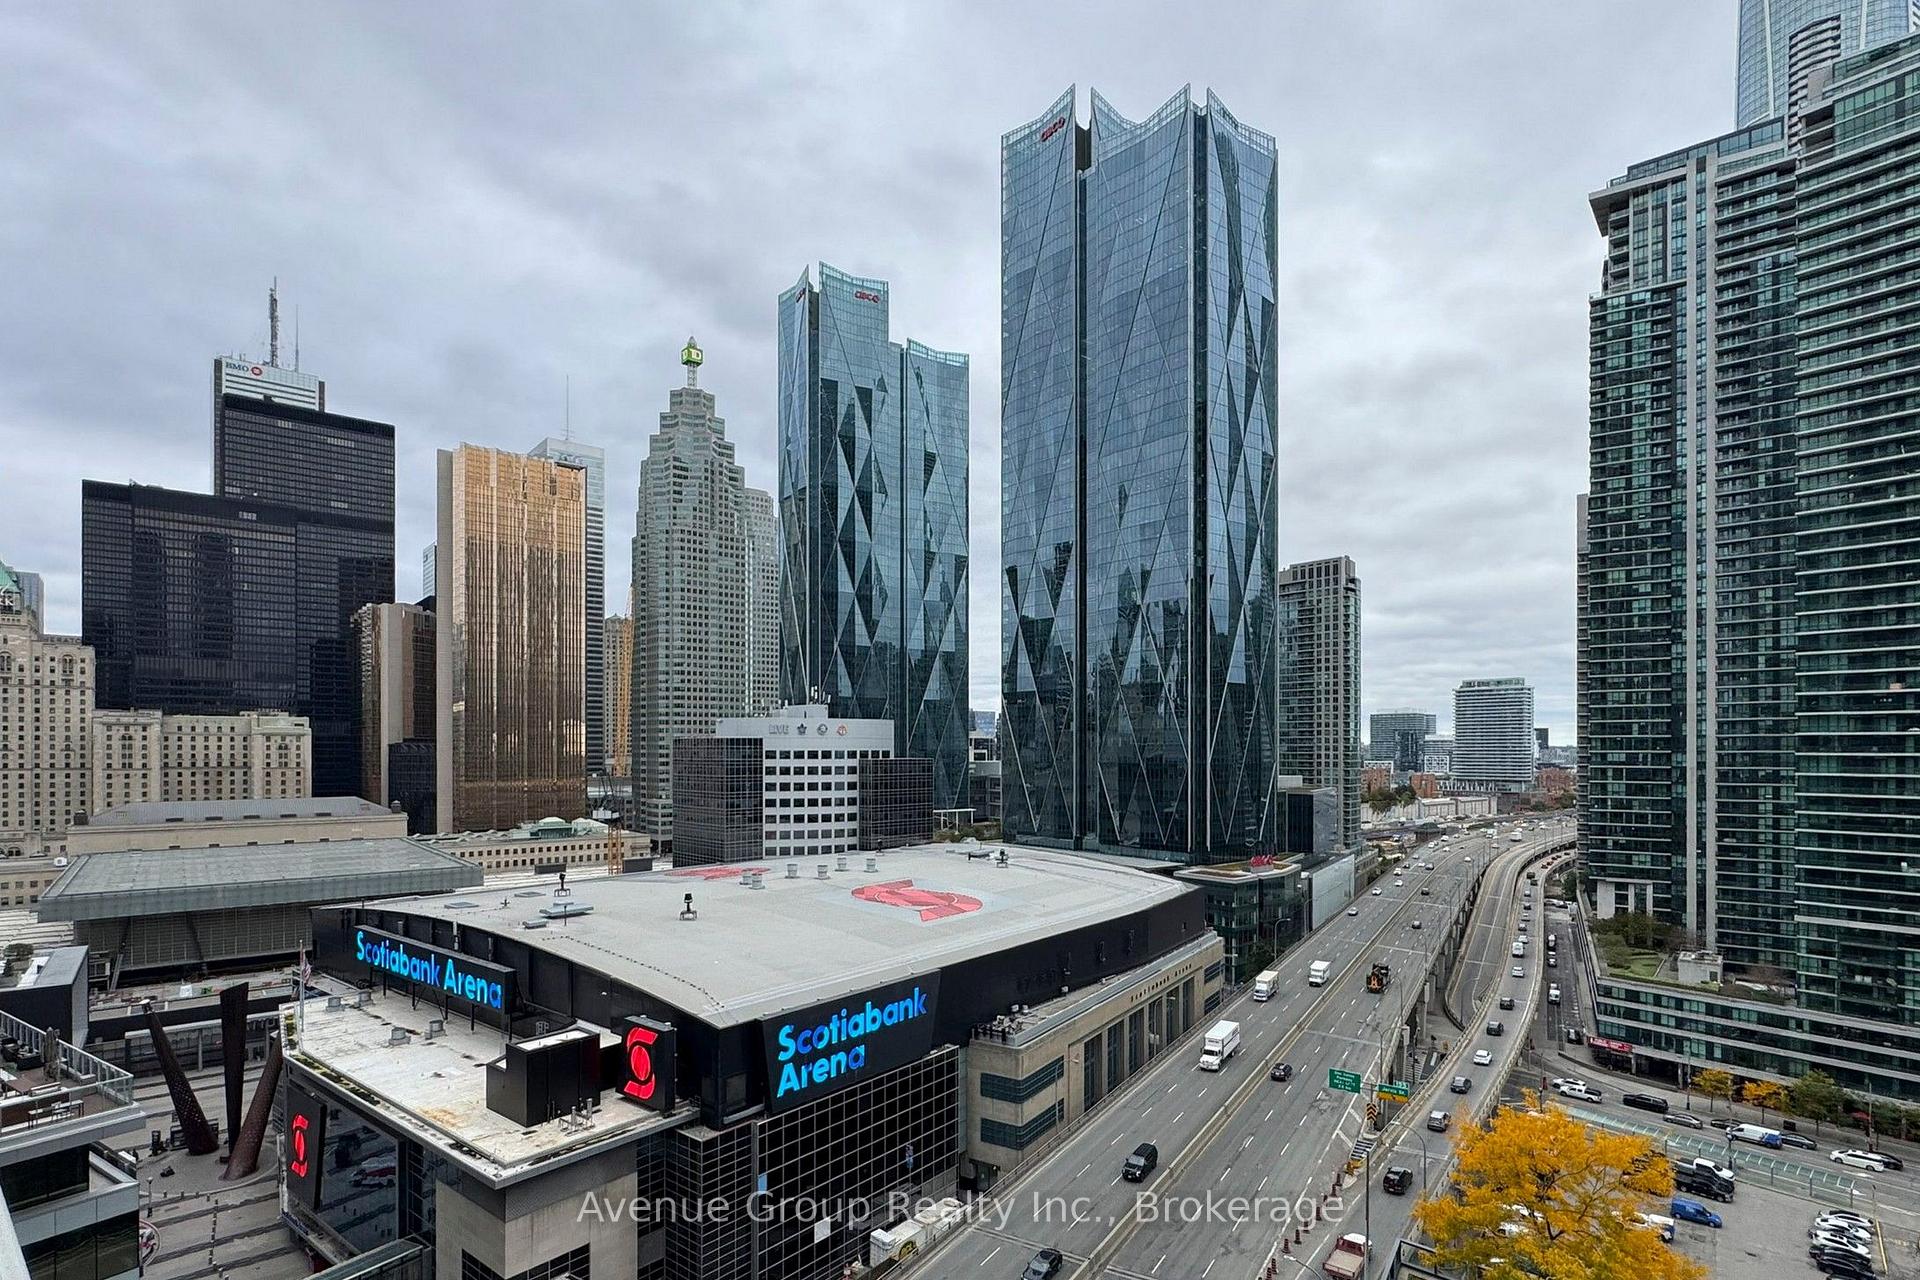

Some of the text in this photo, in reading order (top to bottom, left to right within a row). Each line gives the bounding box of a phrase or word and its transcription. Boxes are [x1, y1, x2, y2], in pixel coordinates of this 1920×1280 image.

[226, 362, 249, 372] BMO
[356, 931, 502, 1009] Scotiabank Arena
[777, 987, 927, 1098] Scotiabank Arena
